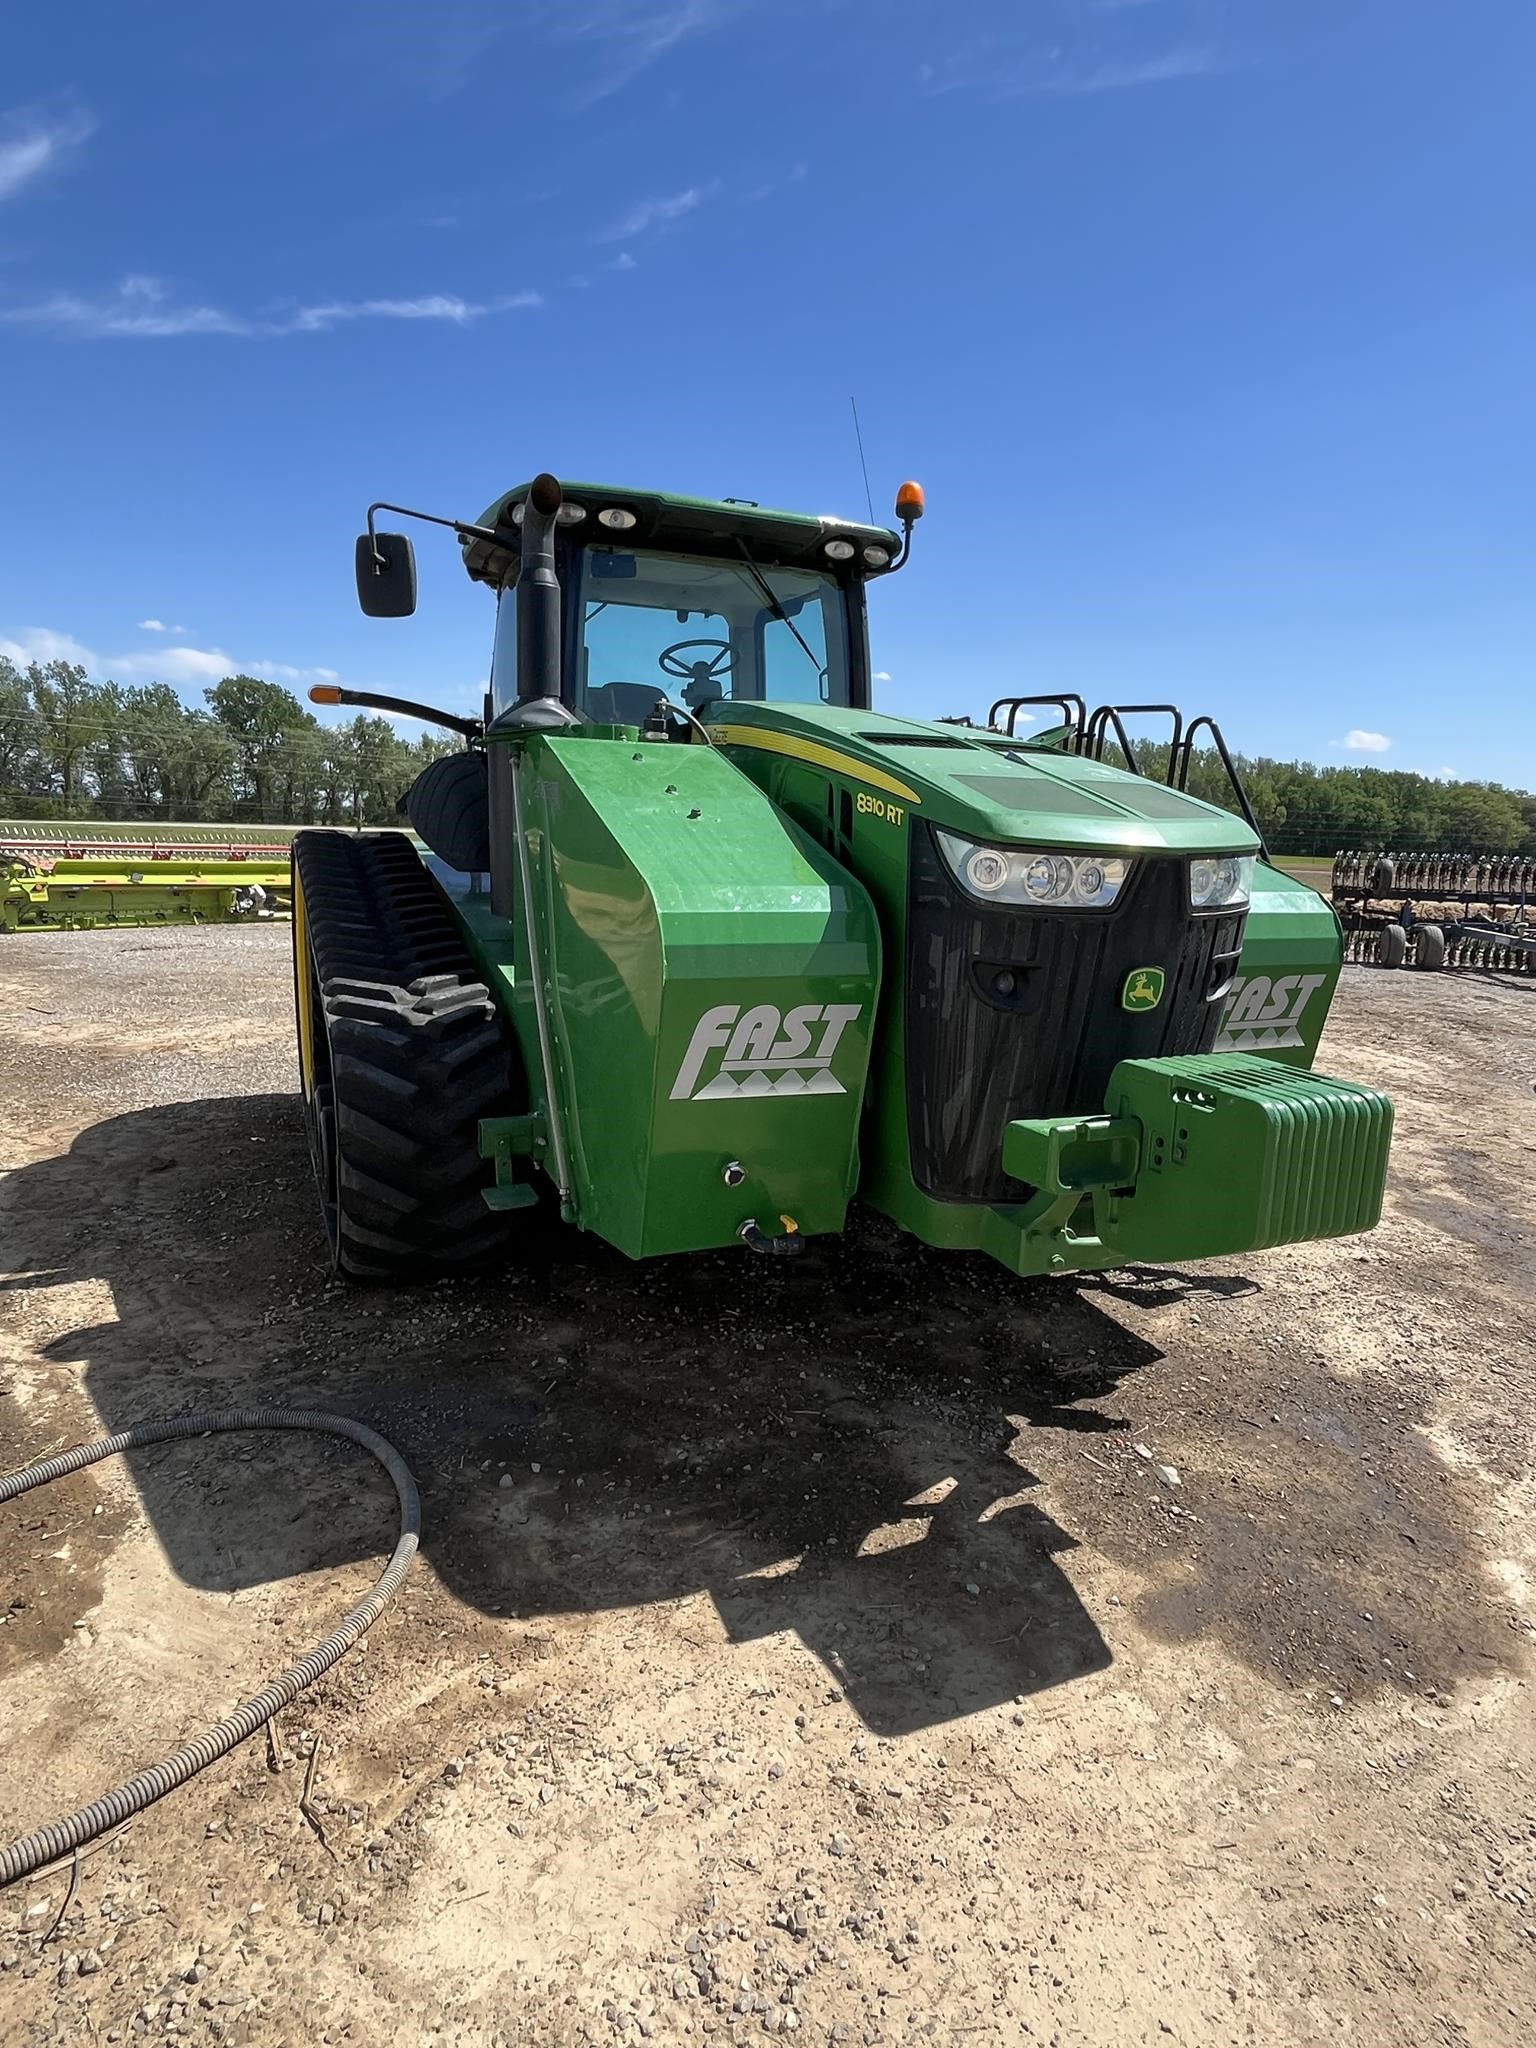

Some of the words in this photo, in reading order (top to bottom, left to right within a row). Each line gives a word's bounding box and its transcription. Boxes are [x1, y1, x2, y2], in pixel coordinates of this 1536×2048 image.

[857, 793, 884, 817] 8310
[886, 803, 904, 826] RT
[669, 1004, 863, 1100] FAST
